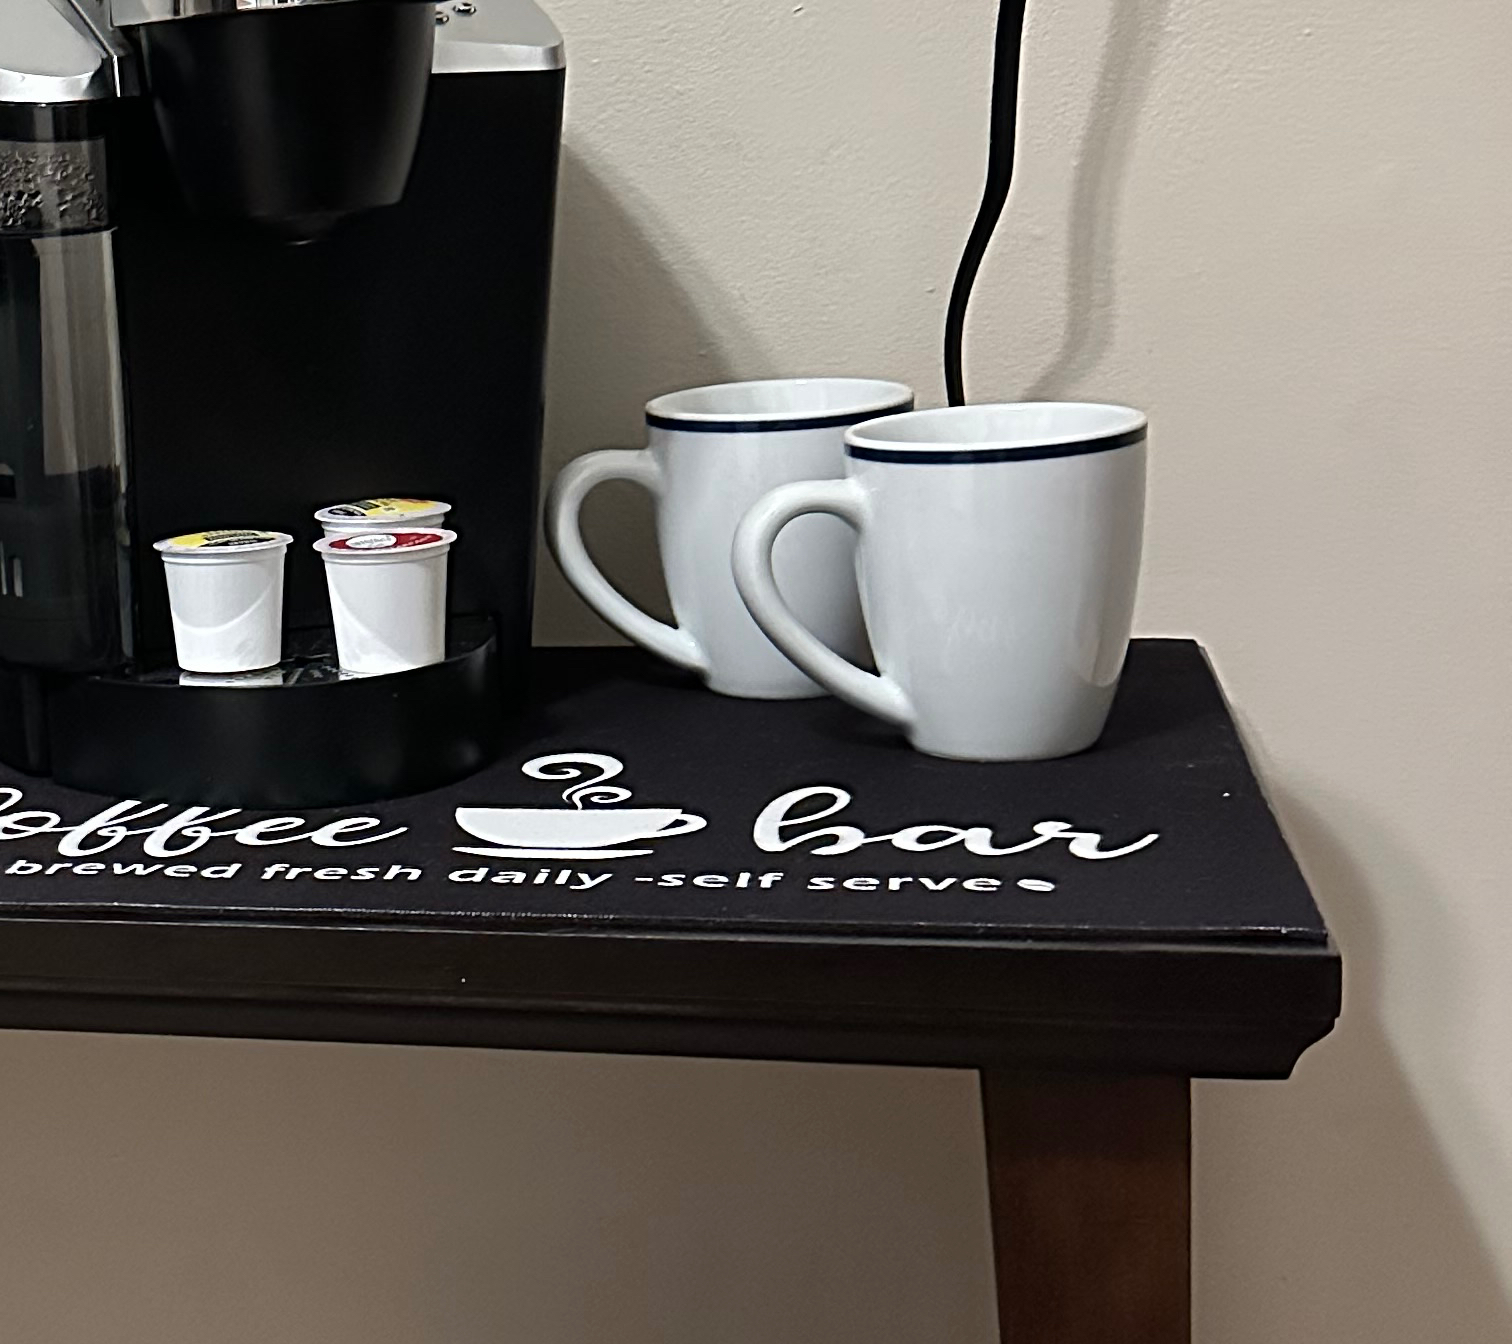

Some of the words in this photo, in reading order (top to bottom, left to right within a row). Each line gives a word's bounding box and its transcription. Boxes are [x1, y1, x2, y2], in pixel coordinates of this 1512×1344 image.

[753, 785, 1160, 860] bar
[4, 859, 243, 879] brewed
[260, 863, 422, 882] fresh
[448, 867, 613, 890] daily
[806, 876, 1002, 892] serve
